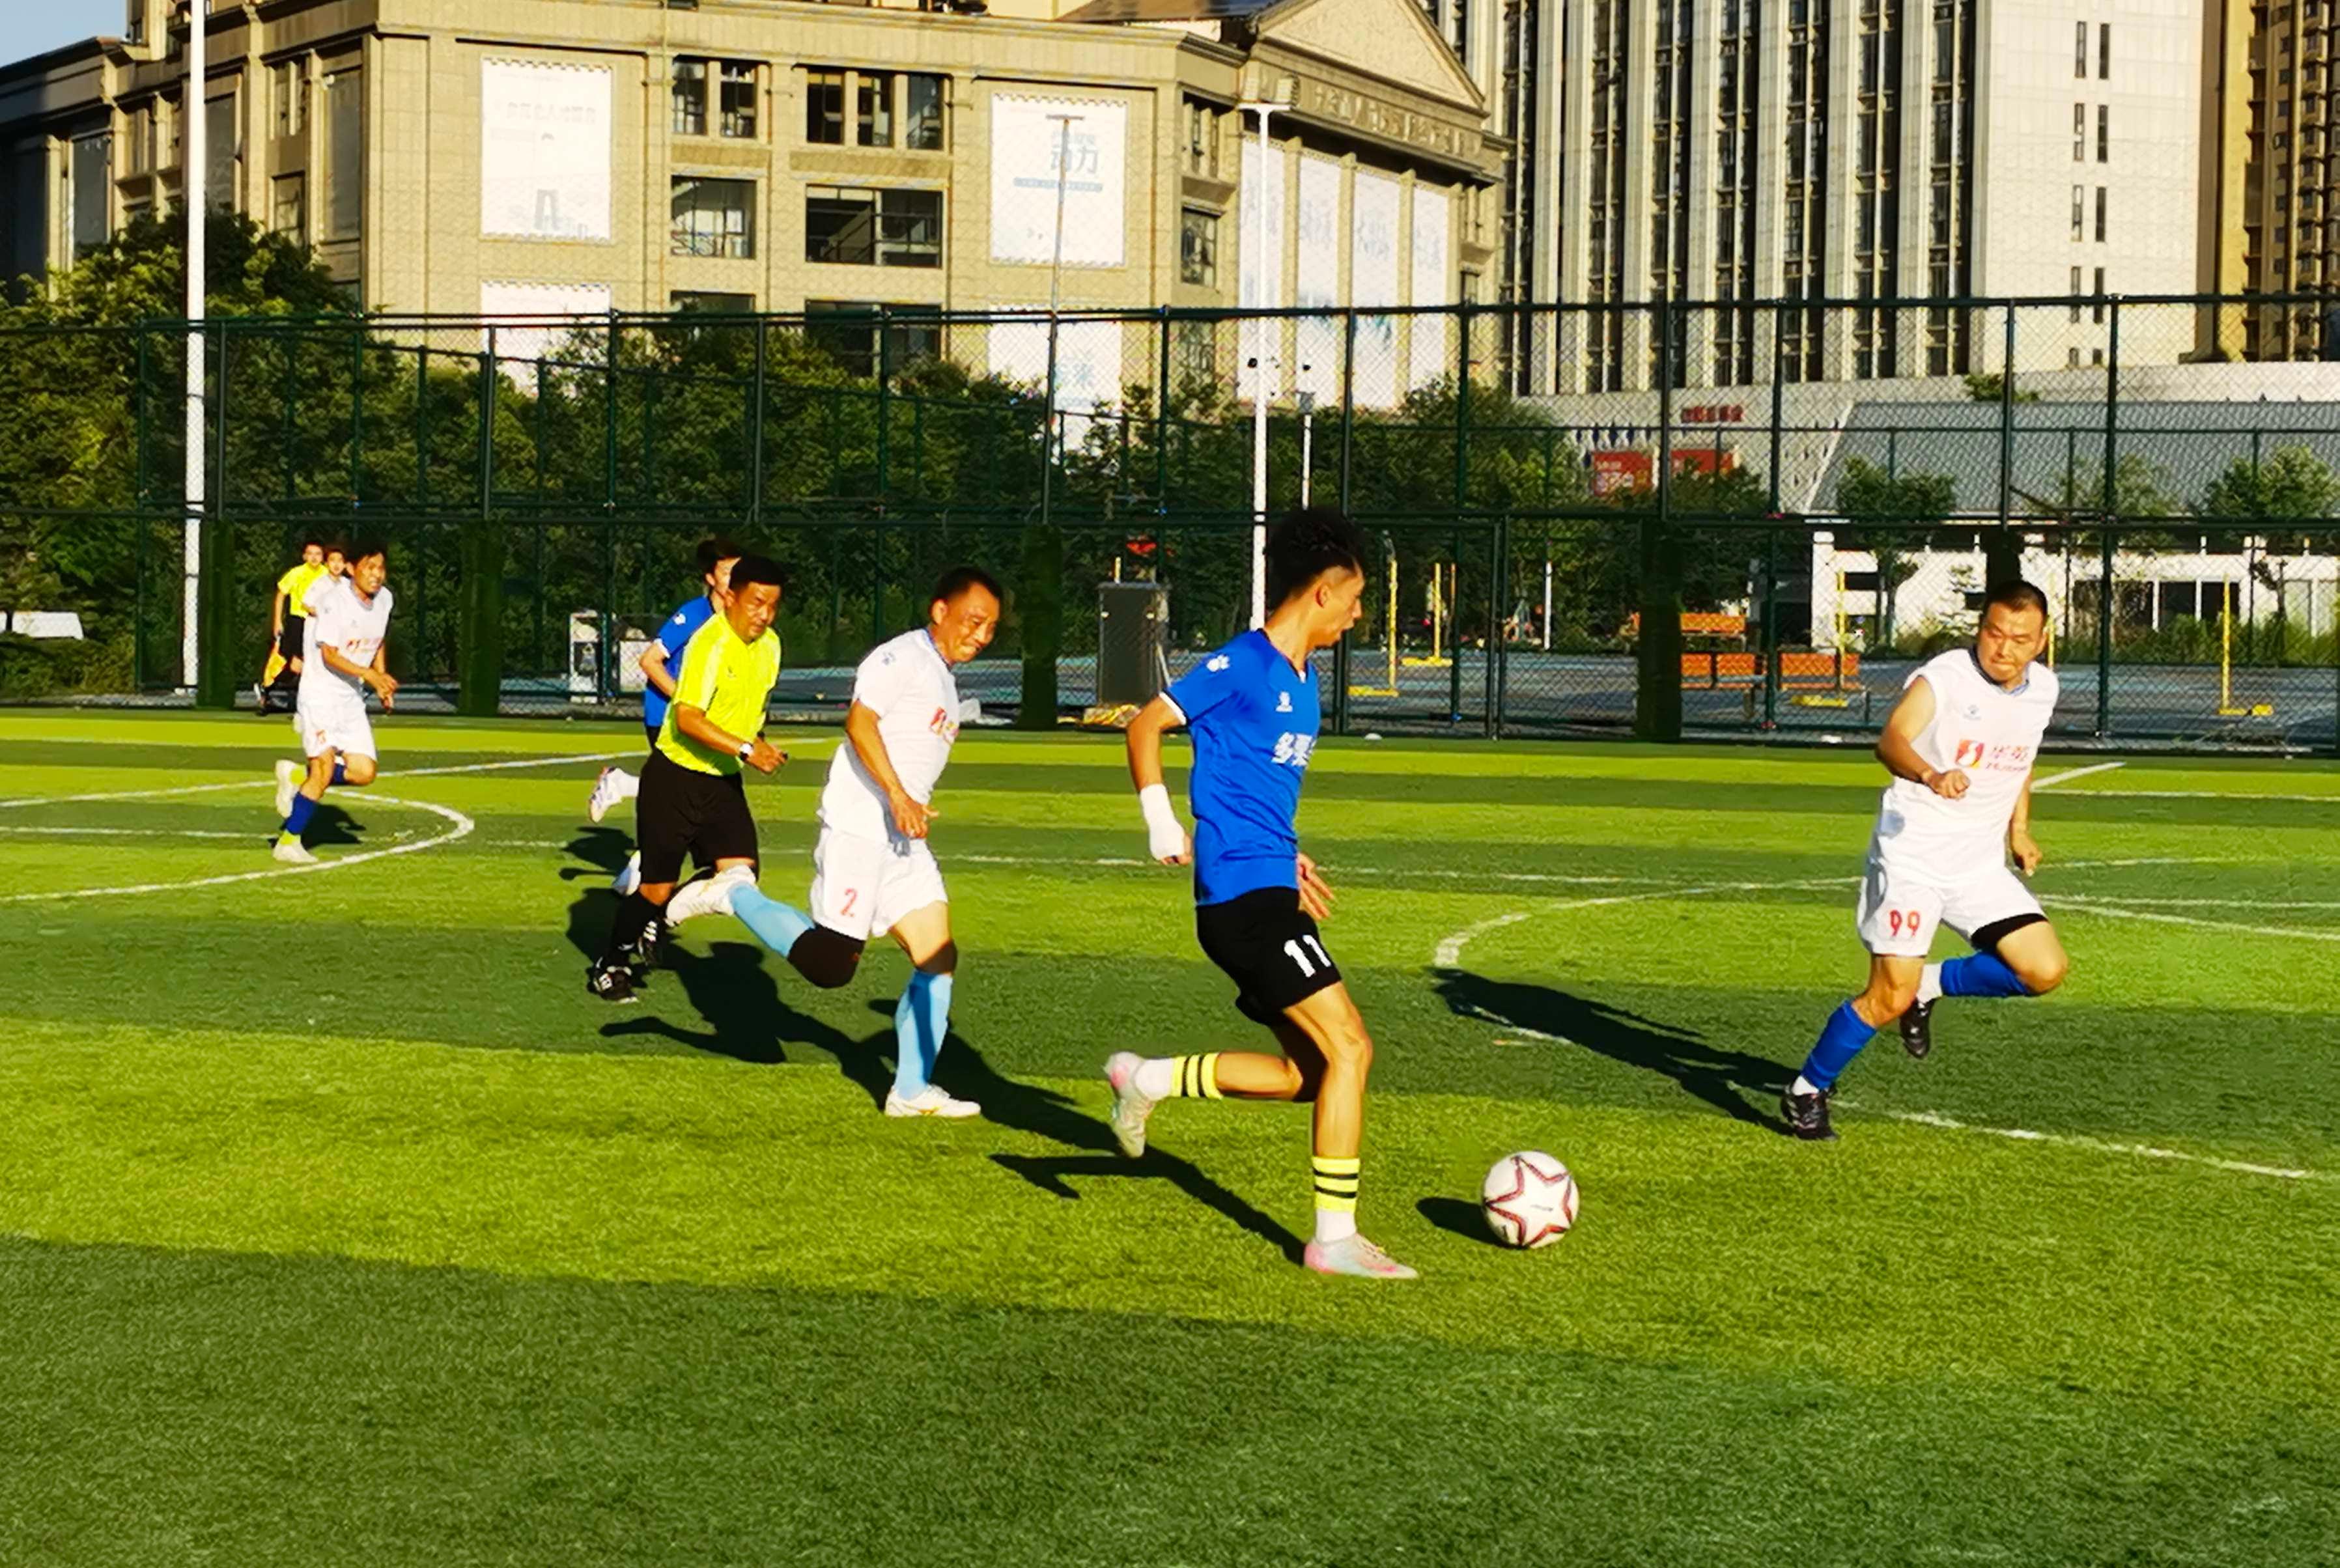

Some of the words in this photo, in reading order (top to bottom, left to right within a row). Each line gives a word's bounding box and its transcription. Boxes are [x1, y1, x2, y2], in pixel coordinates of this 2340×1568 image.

[841, 888, 858, 917] 2
[1889, 910, 1921, 936] 99
[1284, 934, 1331, 977] 11
